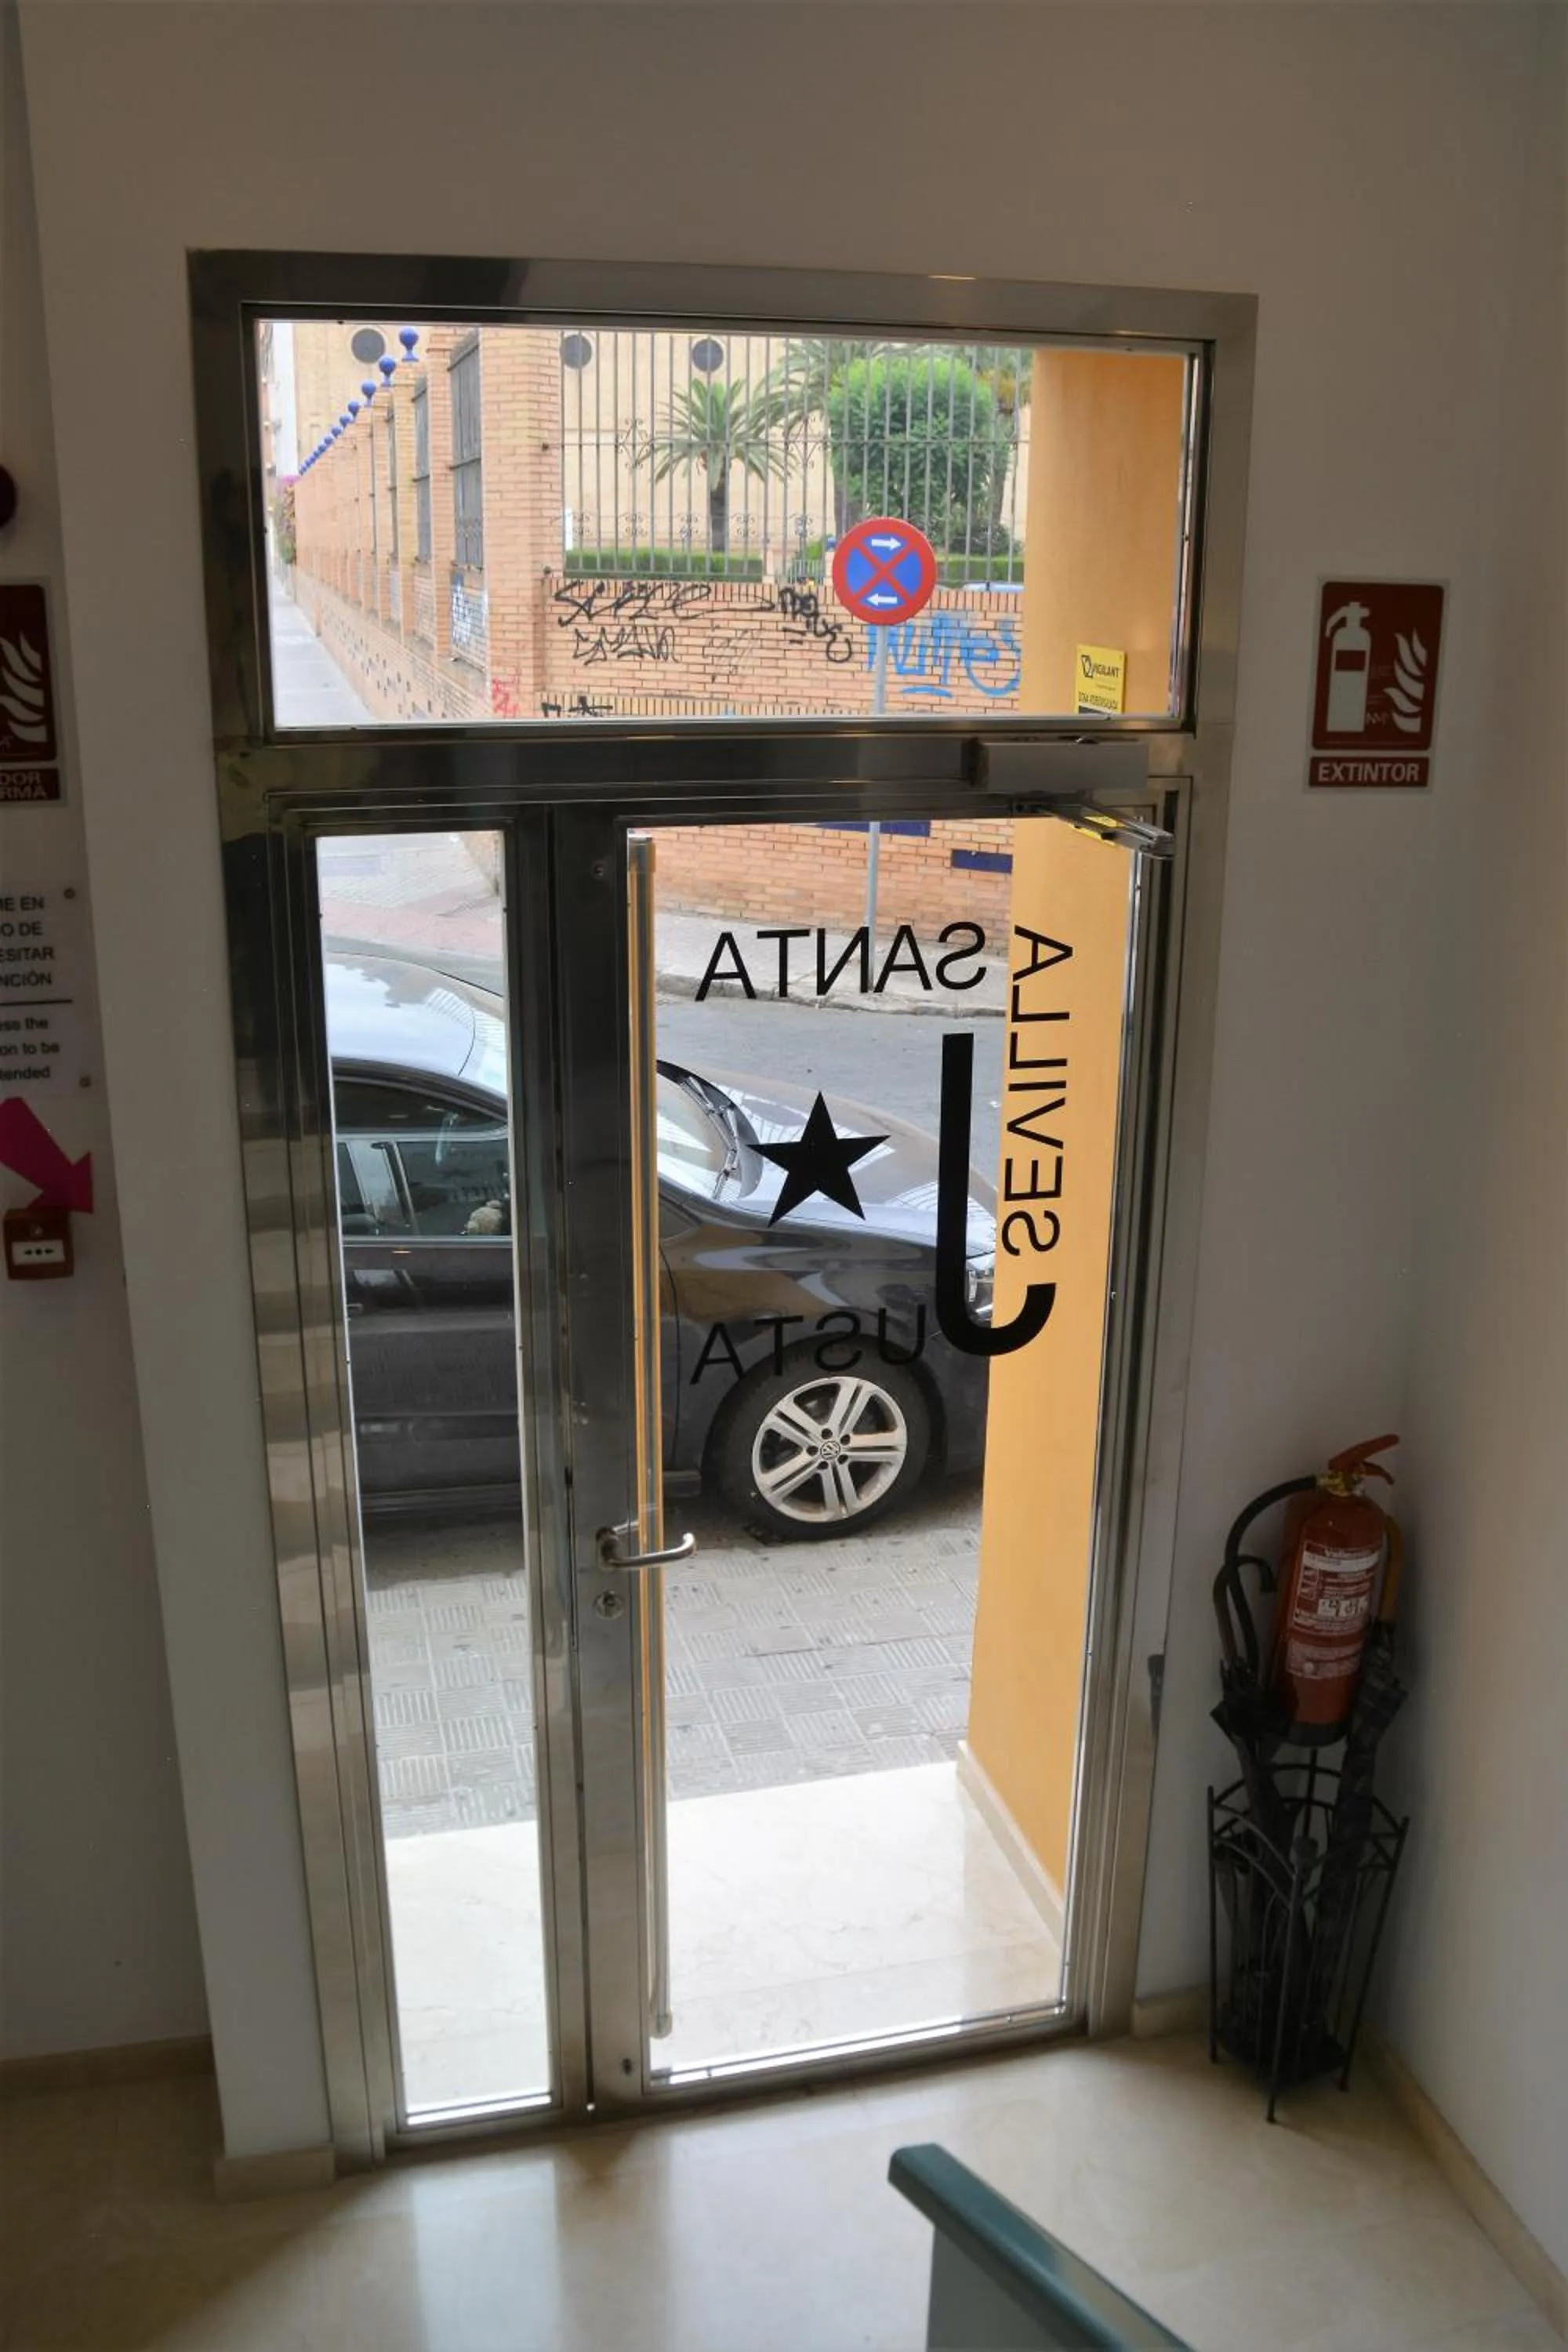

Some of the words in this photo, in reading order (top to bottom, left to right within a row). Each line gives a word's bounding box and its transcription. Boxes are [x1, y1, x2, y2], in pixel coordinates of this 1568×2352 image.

[1317, 763, 1419, 782] EXTINTOR
[20, 896, 45, 910] EN
[19, 921, 42, 936] DE
[25, 1016, 48, 1029] the
[23, 1042, 37, 1054] to
[41, 1041, 60, 1054] be
